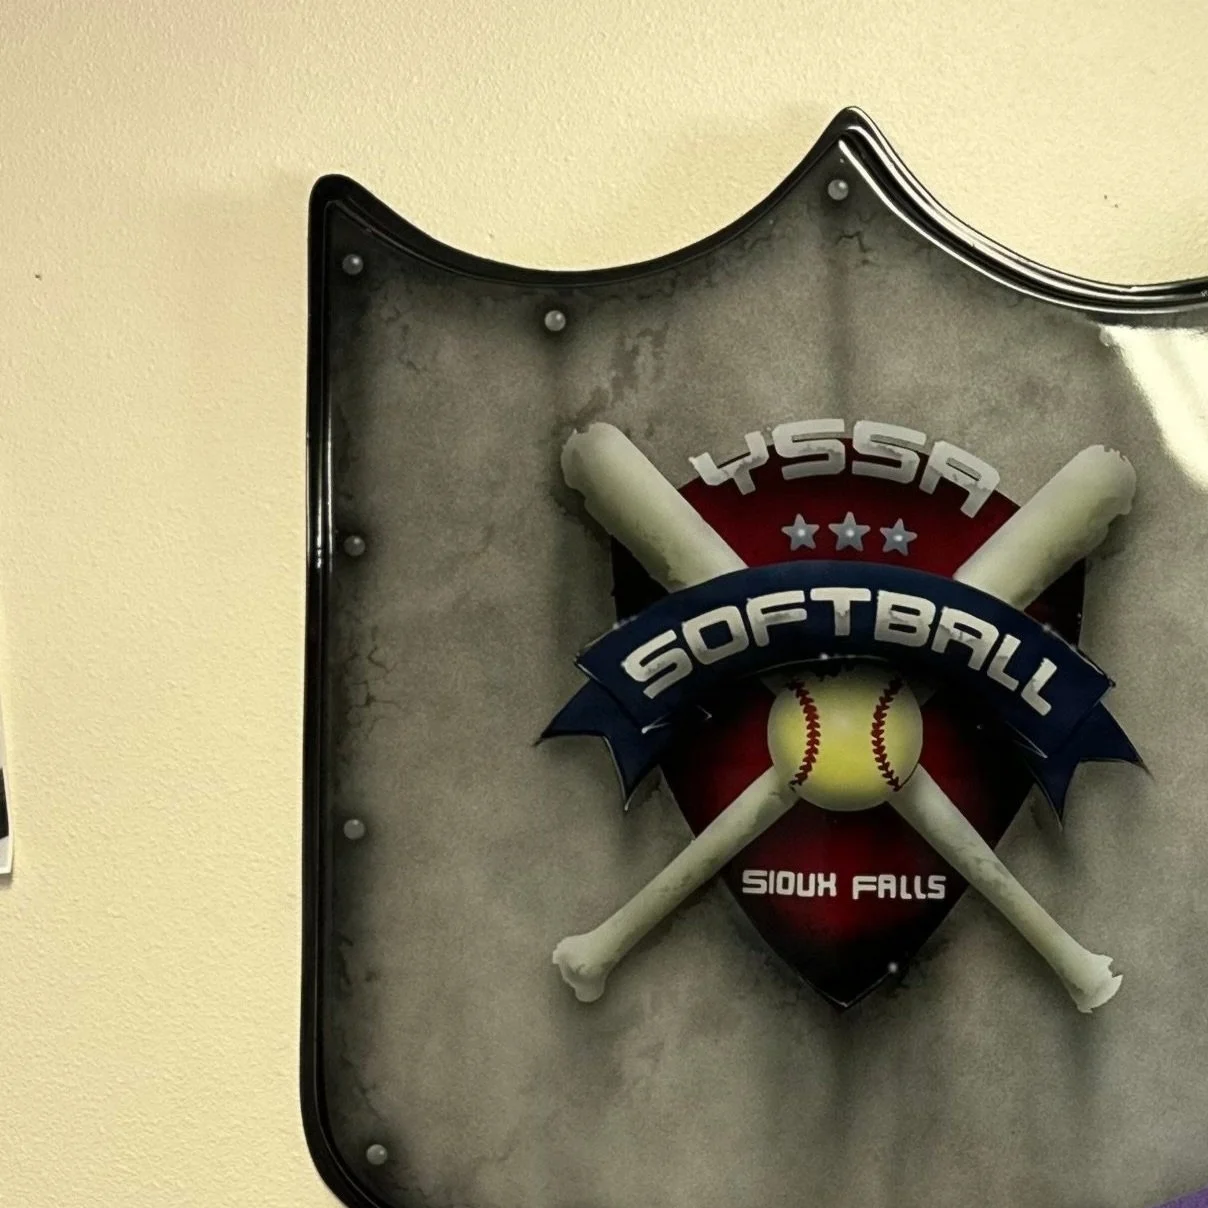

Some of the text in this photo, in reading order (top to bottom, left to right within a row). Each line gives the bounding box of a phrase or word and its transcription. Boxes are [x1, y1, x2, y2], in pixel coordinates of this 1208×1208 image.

[689, 418, 1000, 518] YSSA
[621, 587, 1058, 716] SOFTBALL
[742, 870, 947, 900] SIOUX FALLS
